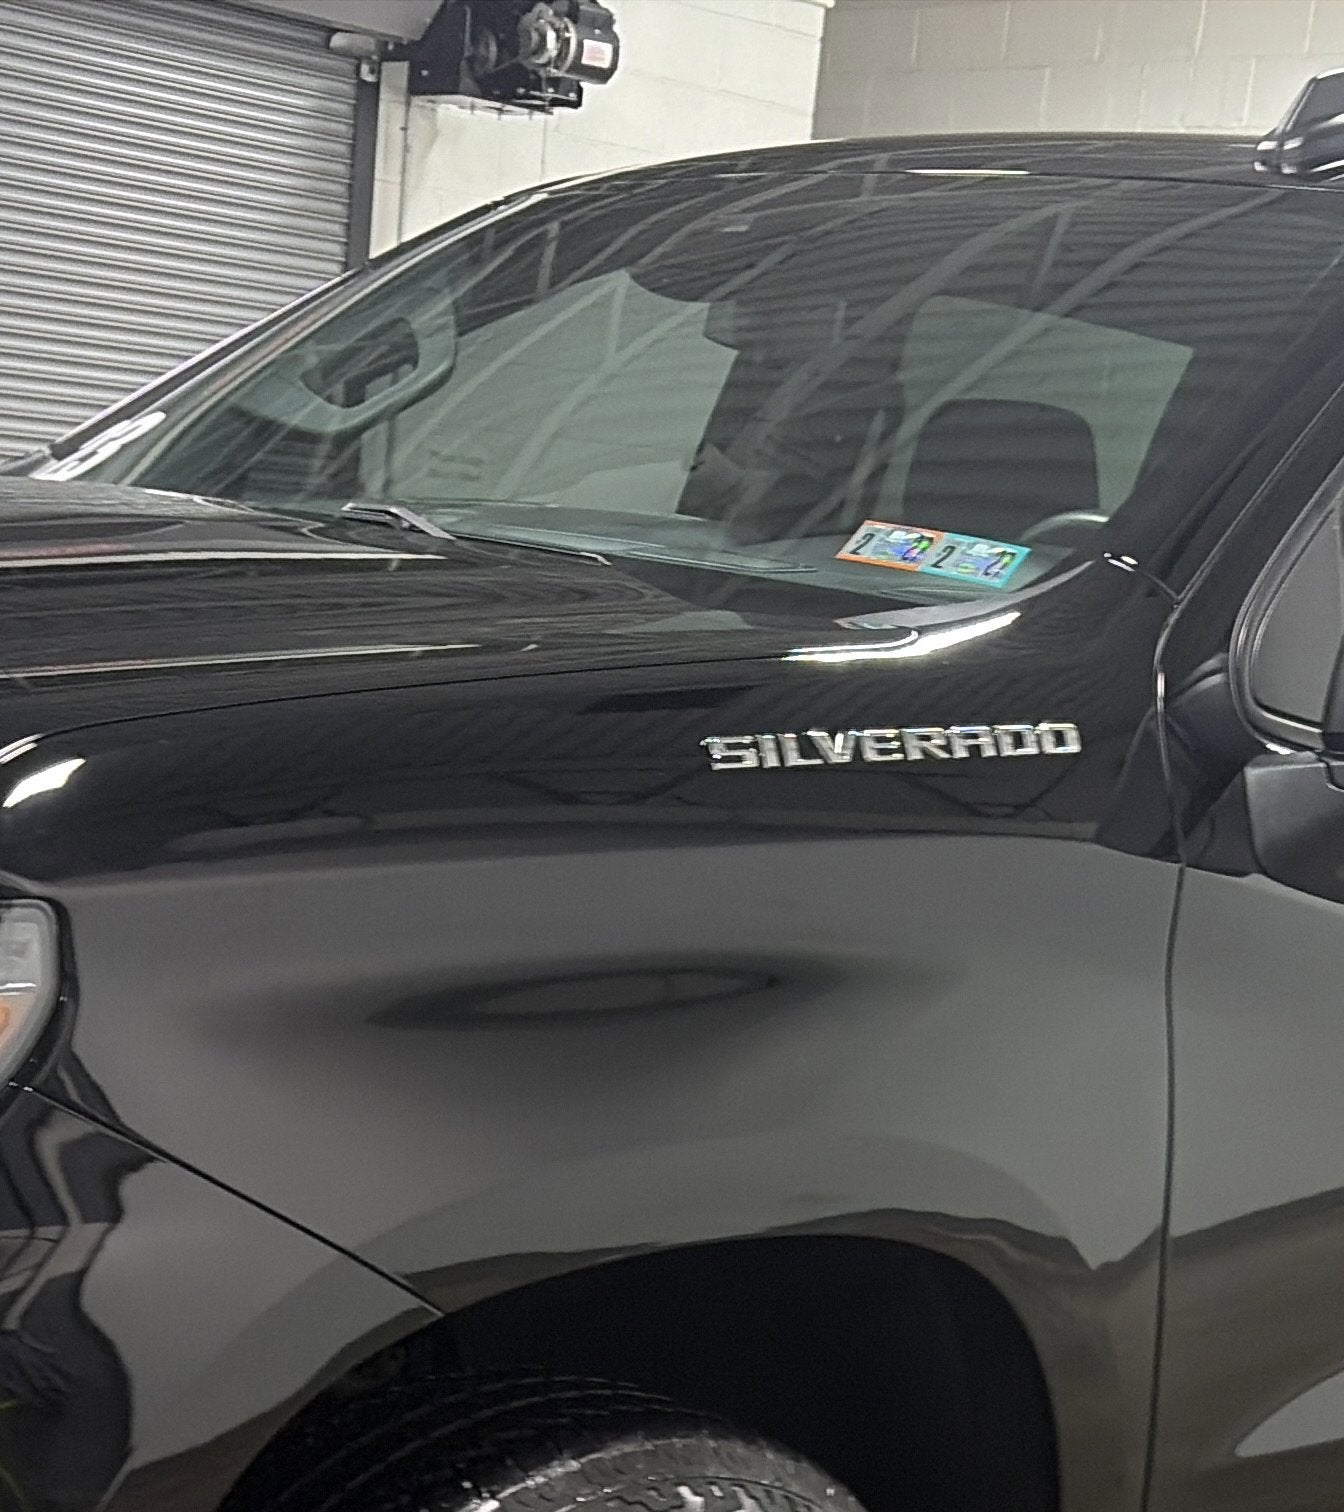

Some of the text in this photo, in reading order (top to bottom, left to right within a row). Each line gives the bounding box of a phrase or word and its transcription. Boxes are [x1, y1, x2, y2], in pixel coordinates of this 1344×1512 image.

[849, 532, 875, 555] 2
[931, 545, 956, 568] 2
[700, 722, 1082, 770] SILVERADO
